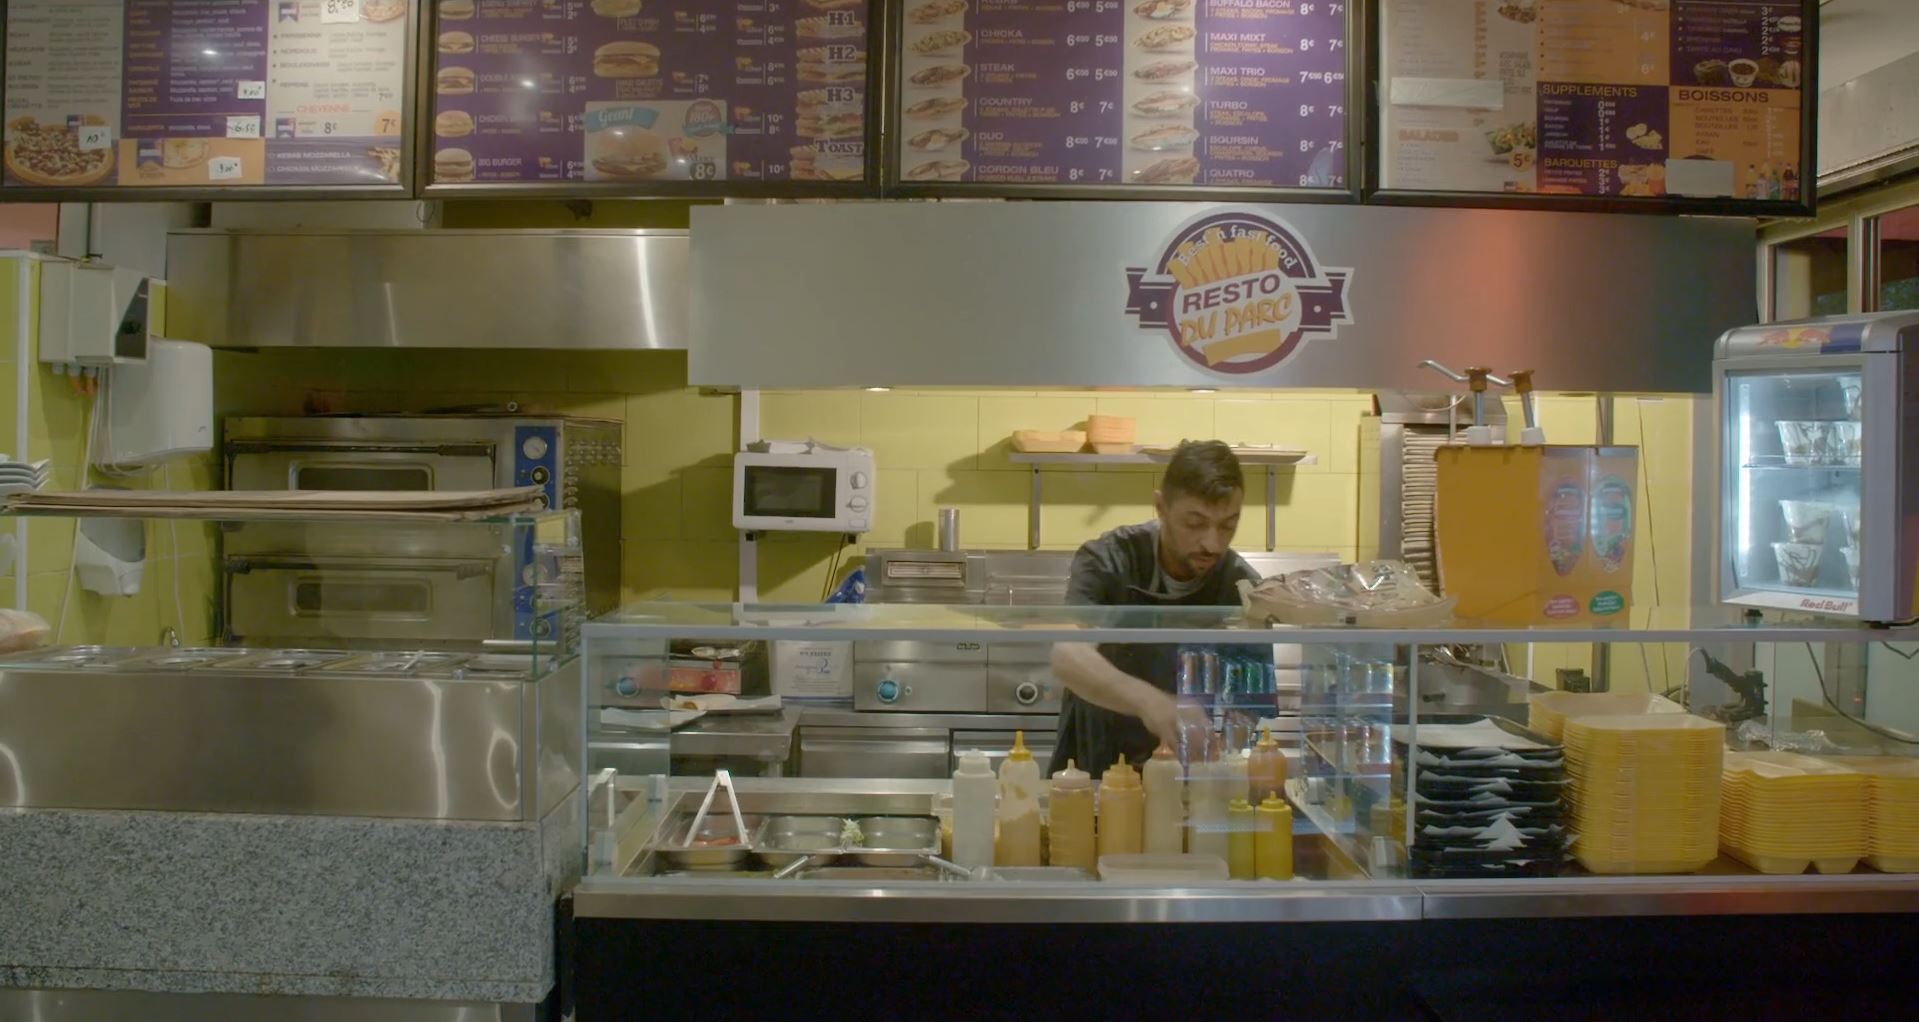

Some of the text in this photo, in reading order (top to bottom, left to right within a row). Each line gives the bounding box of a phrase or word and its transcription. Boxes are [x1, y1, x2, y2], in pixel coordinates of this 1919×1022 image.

[1256, 0, 1290, 8] BACON
[1300, 3, 1315, 15] 8€
[1328, 4, 1344, 16] 7€
[828, 12, 855, 25] H1
[981, 29, 1024, 38] CHICKA
[1210, 33, 1266, 42] MAXI MIXT
[1300, 38, 1315, 51] 8€
[1328, 39, 1344, 52] 7€
[828, 46, 856, 60] H2
[980, 63, 1015, 72] STEAK
[1210, 67, 1266, 76] MAXI TRIO
[827, 89, 854, 102] H3
[1542, 84, 1637, 98] SUPPLEMENTS
[1679, 90, 1769, 103] BOISSONS
[979, 97, 1033, 106] COUNTRY
[1070, 100, 1086, 114] 8€
[1099, 101, 1115, 114] 7€
[1210, 101, 1248, 110] TURBO
[1300, 104, 1344, 118] 8€ 7€
[979, 132, 1004, 140] DUO
[1209, 136, 1259, 145] BOURSIN
[1300, 139, 1344, 153] 8€ 7€
[978, 164, 1060, 175] CORDON BLEU
[1544, 158, 1618, 169] BARQUETTES
[1069, 168, 1084, 181] 8€
[1099, 168, 1114, 181] 7€
[1209, 169, 1255, 178] QUATRO
[1230, 224, 1263, 242] fast
[1264, 234, 1299, 270] food
[1182, 273, 1281, 315] RESTO
[1178, 291, 1292, 348] DU PARC
